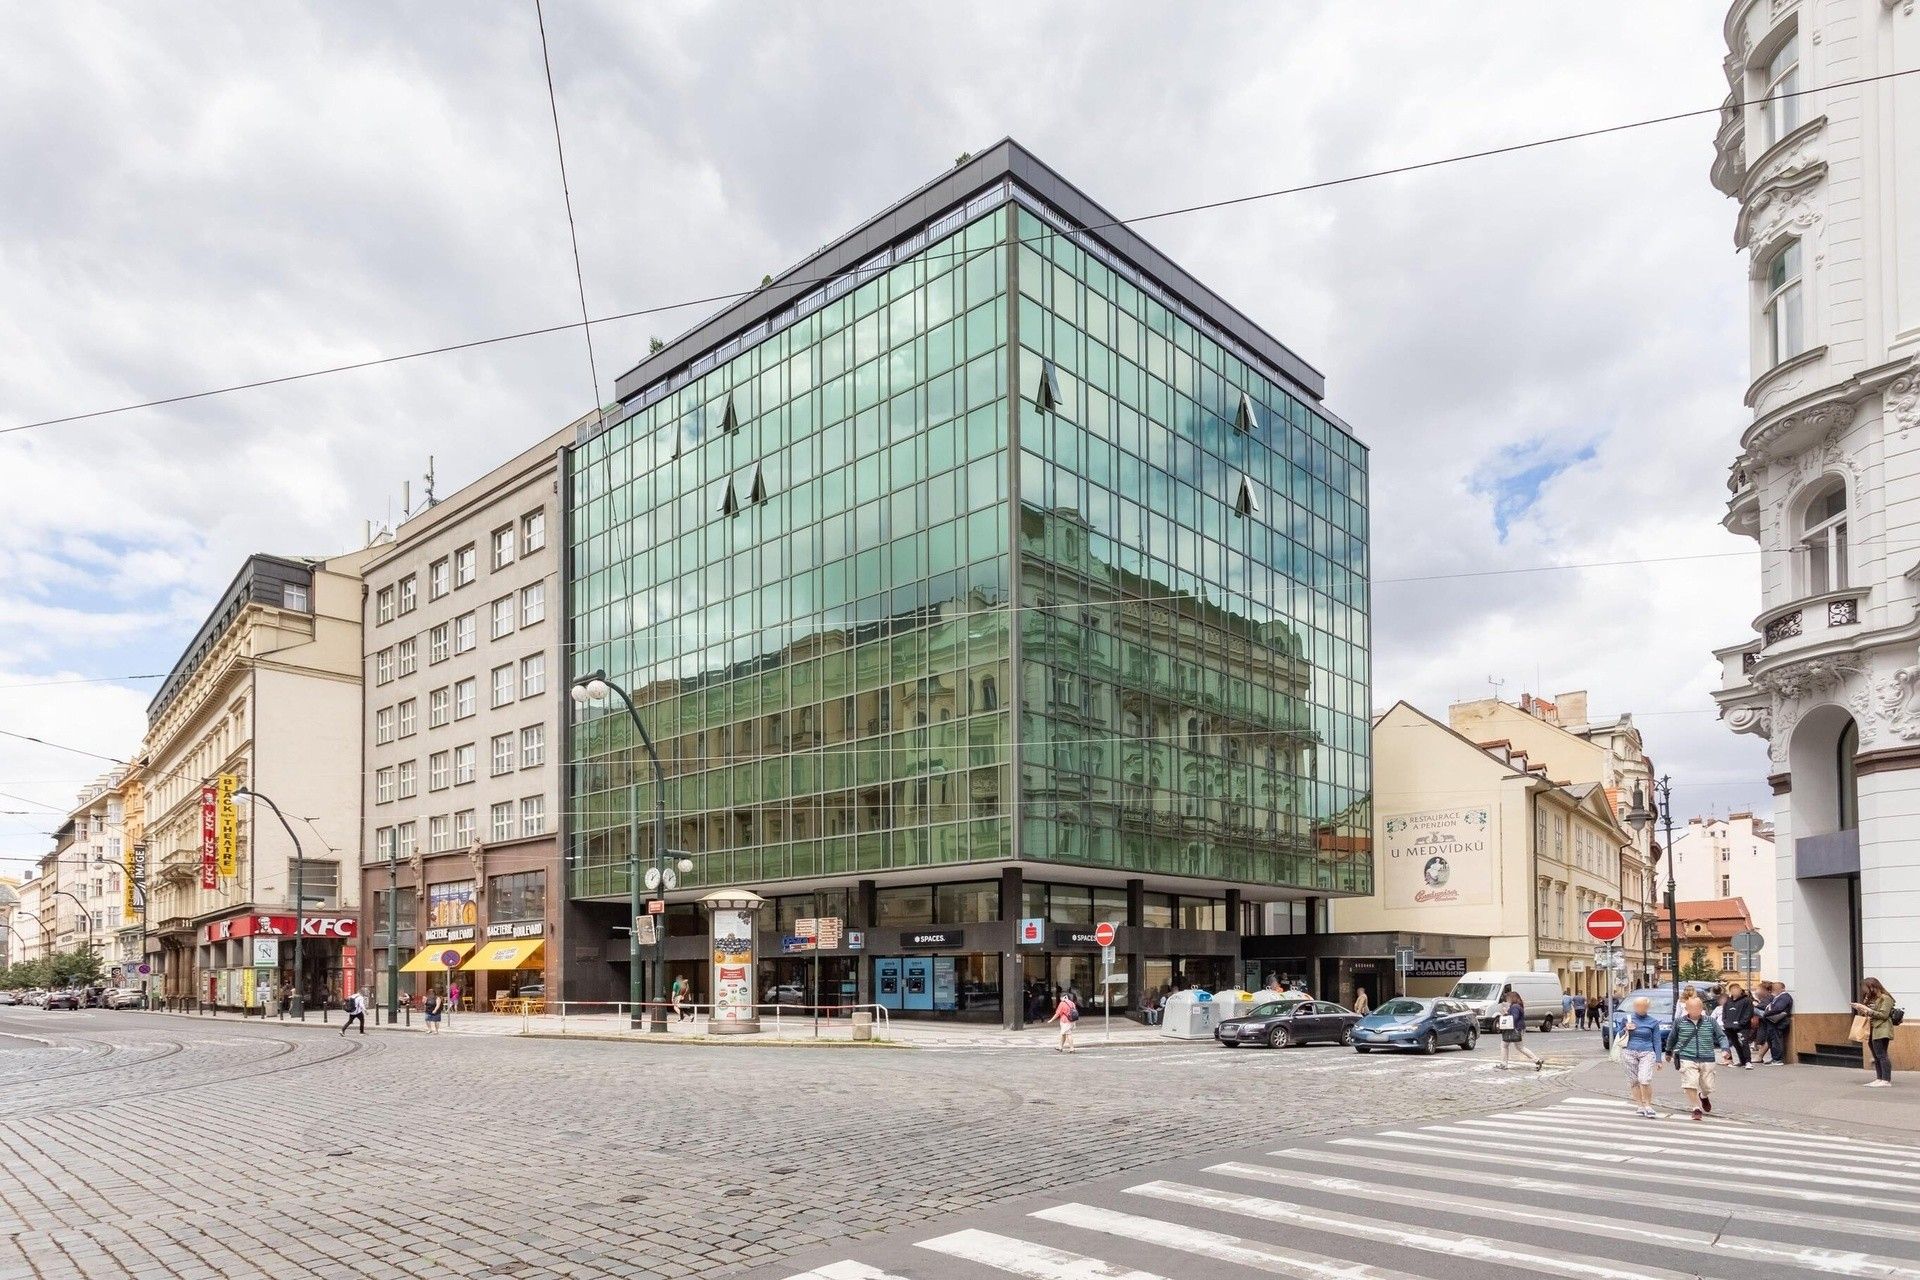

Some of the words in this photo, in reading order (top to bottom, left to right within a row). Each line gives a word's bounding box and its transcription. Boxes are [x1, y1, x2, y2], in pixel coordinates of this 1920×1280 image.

[223, 779, 232, 812] BLACK
[205, 809, 215, 831] KFC
[1409, 812, 1460, 823] RESTAURACE
[1421, 820, 1457, 829] PENZION
[205, 836, 215, 858] KFC
[223, 819, 232, 866] THEATRE
[1391, 848, 1400, 858] U
[135, 850, 145, 879] IMAGE
[205, 863, 215, 885] KFC
[294, 917, 355, 936] KFC
